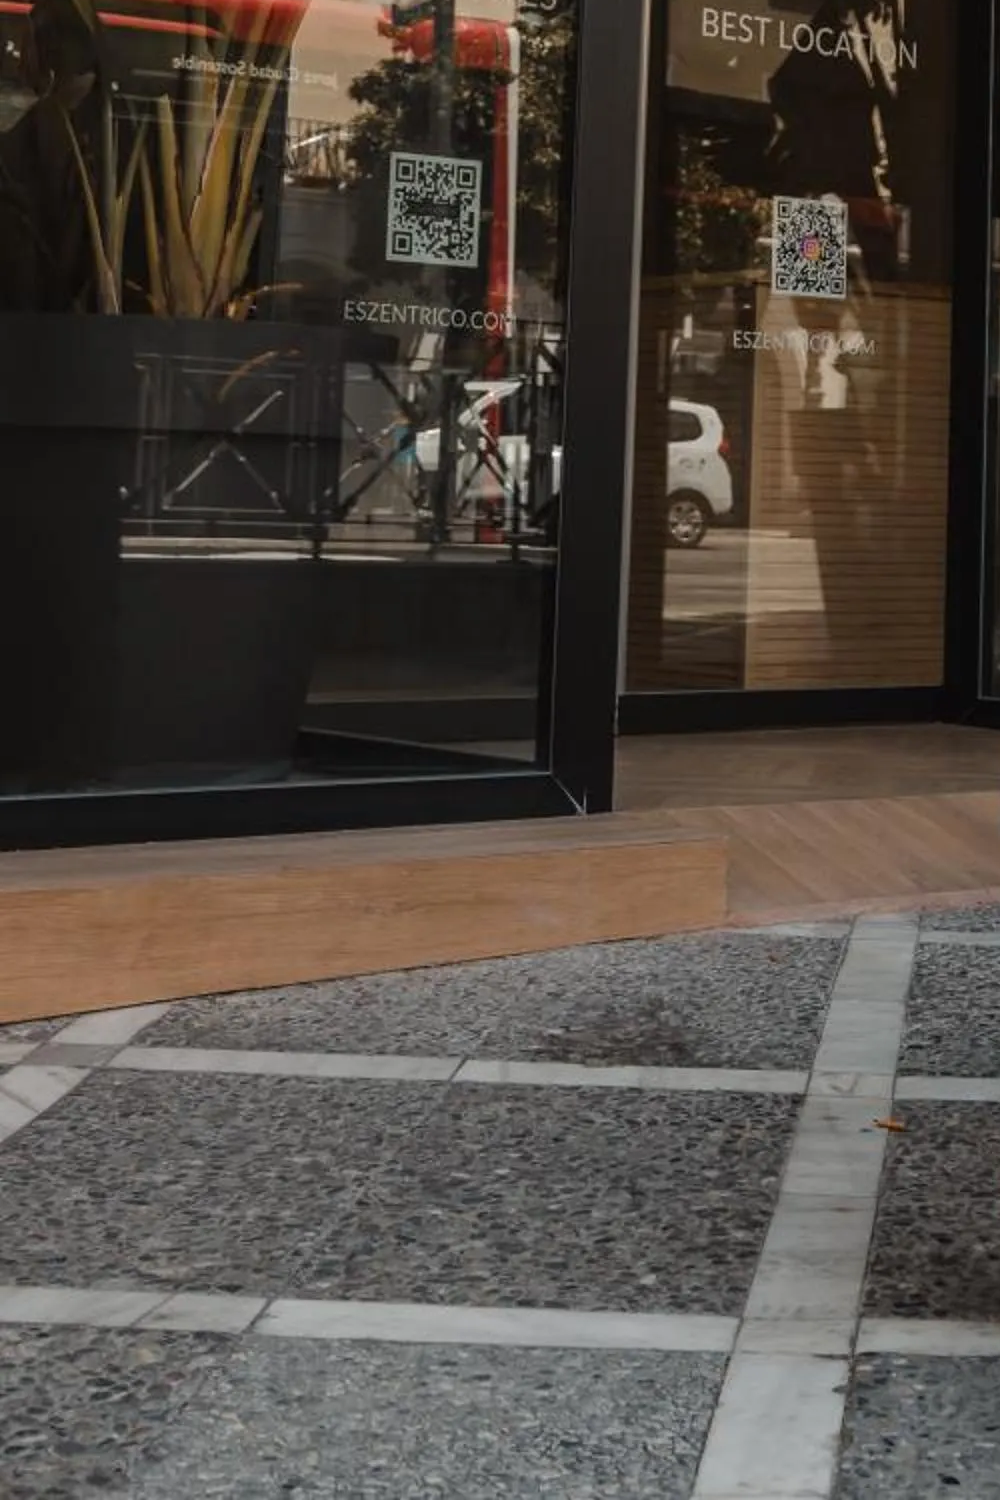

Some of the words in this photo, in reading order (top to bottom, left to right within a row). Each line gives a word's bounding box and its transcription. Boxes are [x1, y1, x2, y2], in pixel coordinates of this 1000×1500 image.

[702, 7, 773, 47] BEST
[779, 19, 918, 69] LOCATION
[343, 300, 516, 332] ESZENTRICO.COM
[733, 329, 875, 356] ESZENCOOM
